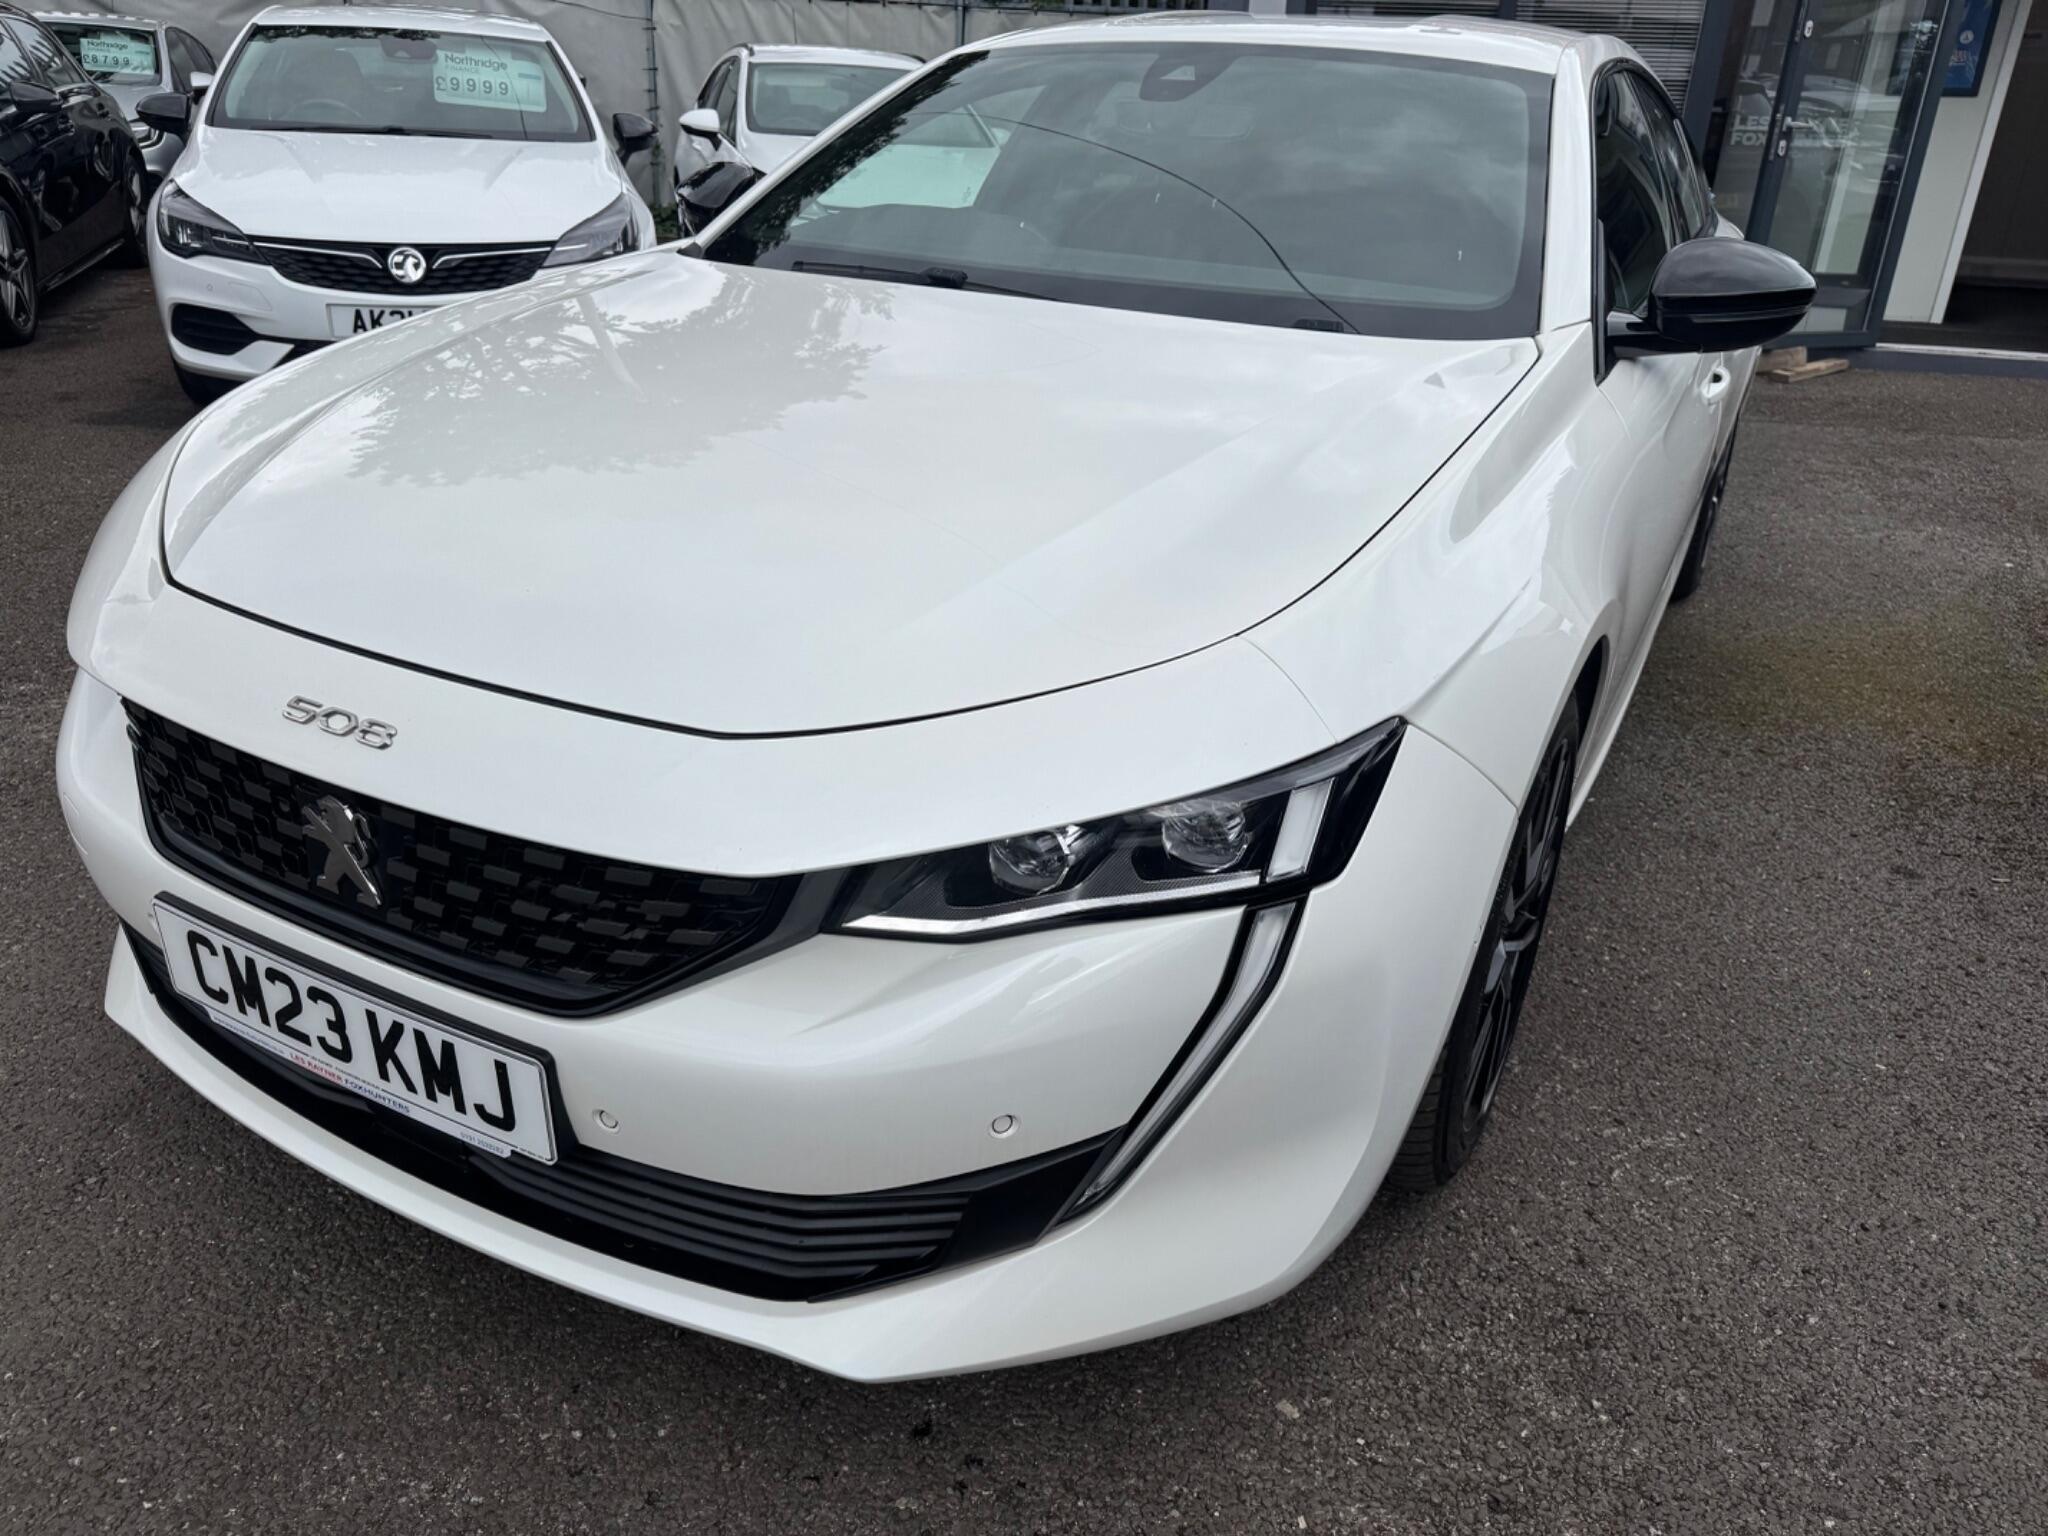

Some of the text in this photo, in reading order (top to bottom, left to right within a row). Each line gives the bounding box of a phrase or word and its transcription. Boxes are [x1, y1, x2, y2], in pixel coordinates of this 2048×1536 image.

[444, 53, 508, 72] Northridge
[435, 75, 509, 96] £9999
[282, 695, 398, 750] 508
[187, 929, 516, 1132] CM23 KMJ
[344, 1077, 411, 1114] FOXHUNTERS
